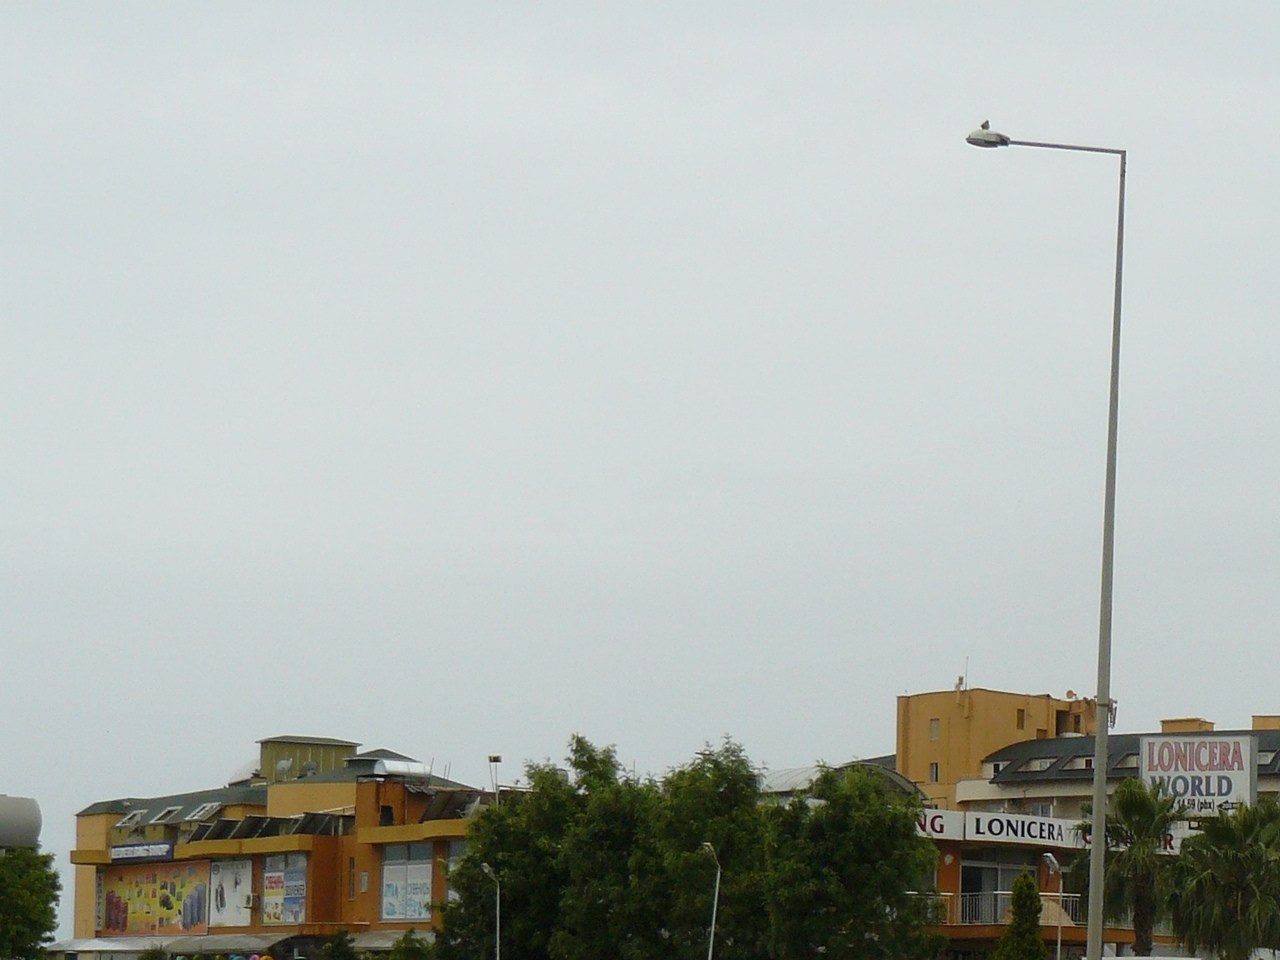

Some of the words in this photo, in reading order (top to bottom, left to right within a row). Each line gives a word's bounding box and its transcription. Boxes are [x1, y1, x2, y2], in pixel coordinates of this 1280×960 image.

[1147, 741, 1245, 772] LONICERA
[1150, 775, 1233, 797] WORLD
[975, 817, 1064, 842] LONICERA
